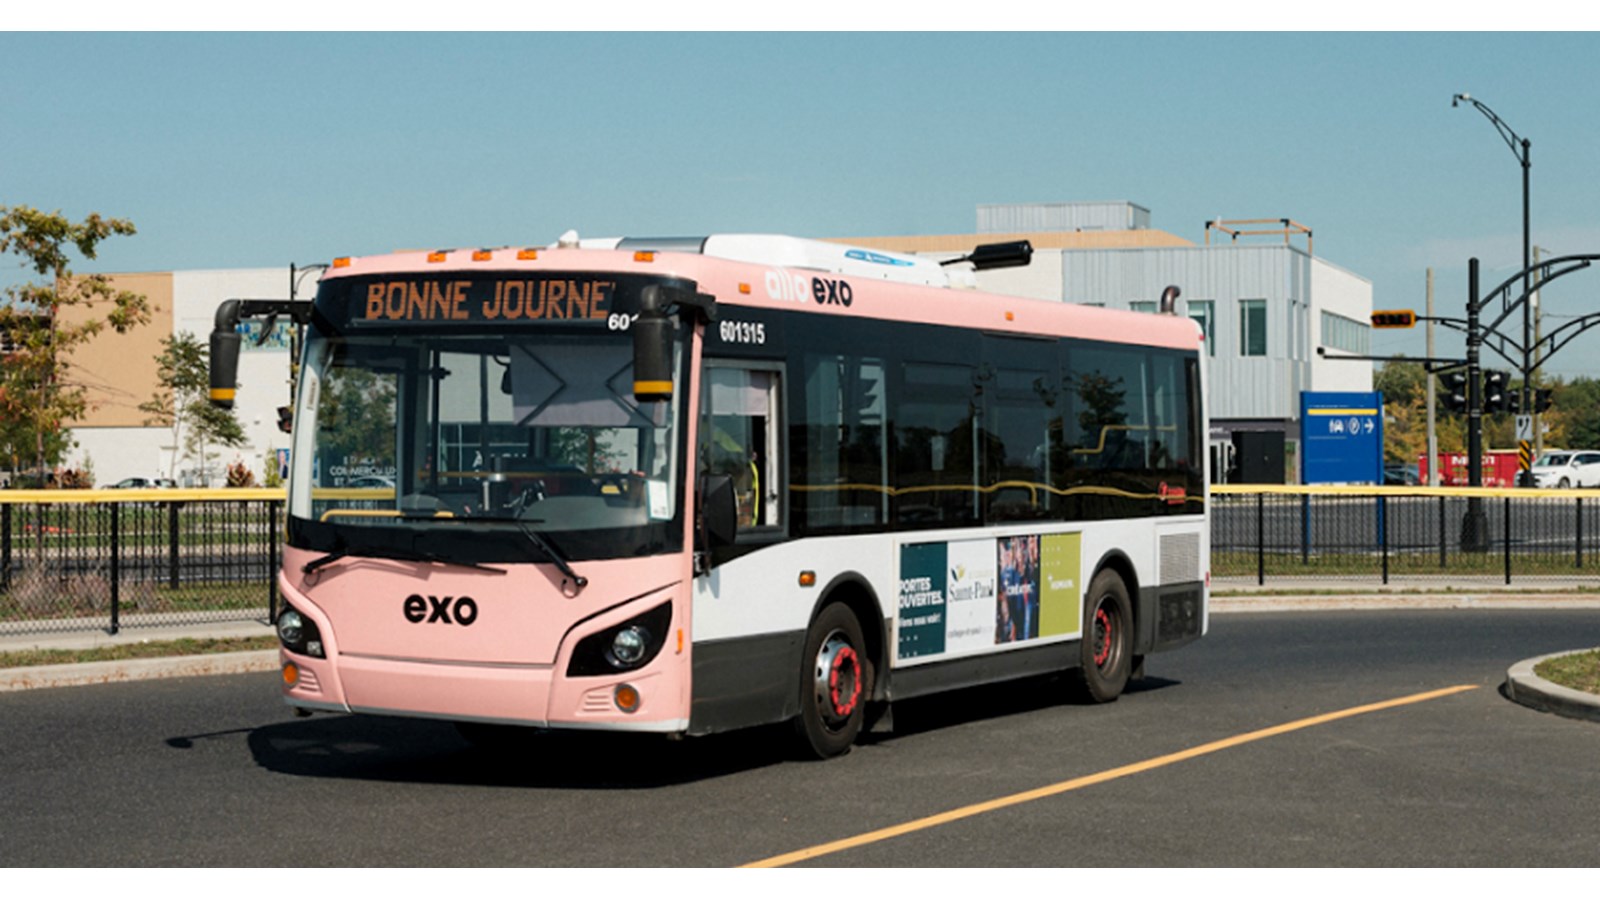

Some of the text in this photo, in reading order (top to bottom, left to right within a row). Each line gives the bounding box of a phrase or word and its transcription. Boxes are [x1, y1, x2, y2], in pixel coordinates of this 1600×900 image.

[366, 282, 472, 320] BONNE
[765, 266, 853, 307] allo exo
[720, 320, 765, 344] 601315
[898, 577, 932, 593] PORTES
[403, 593, 478, 627] exo
